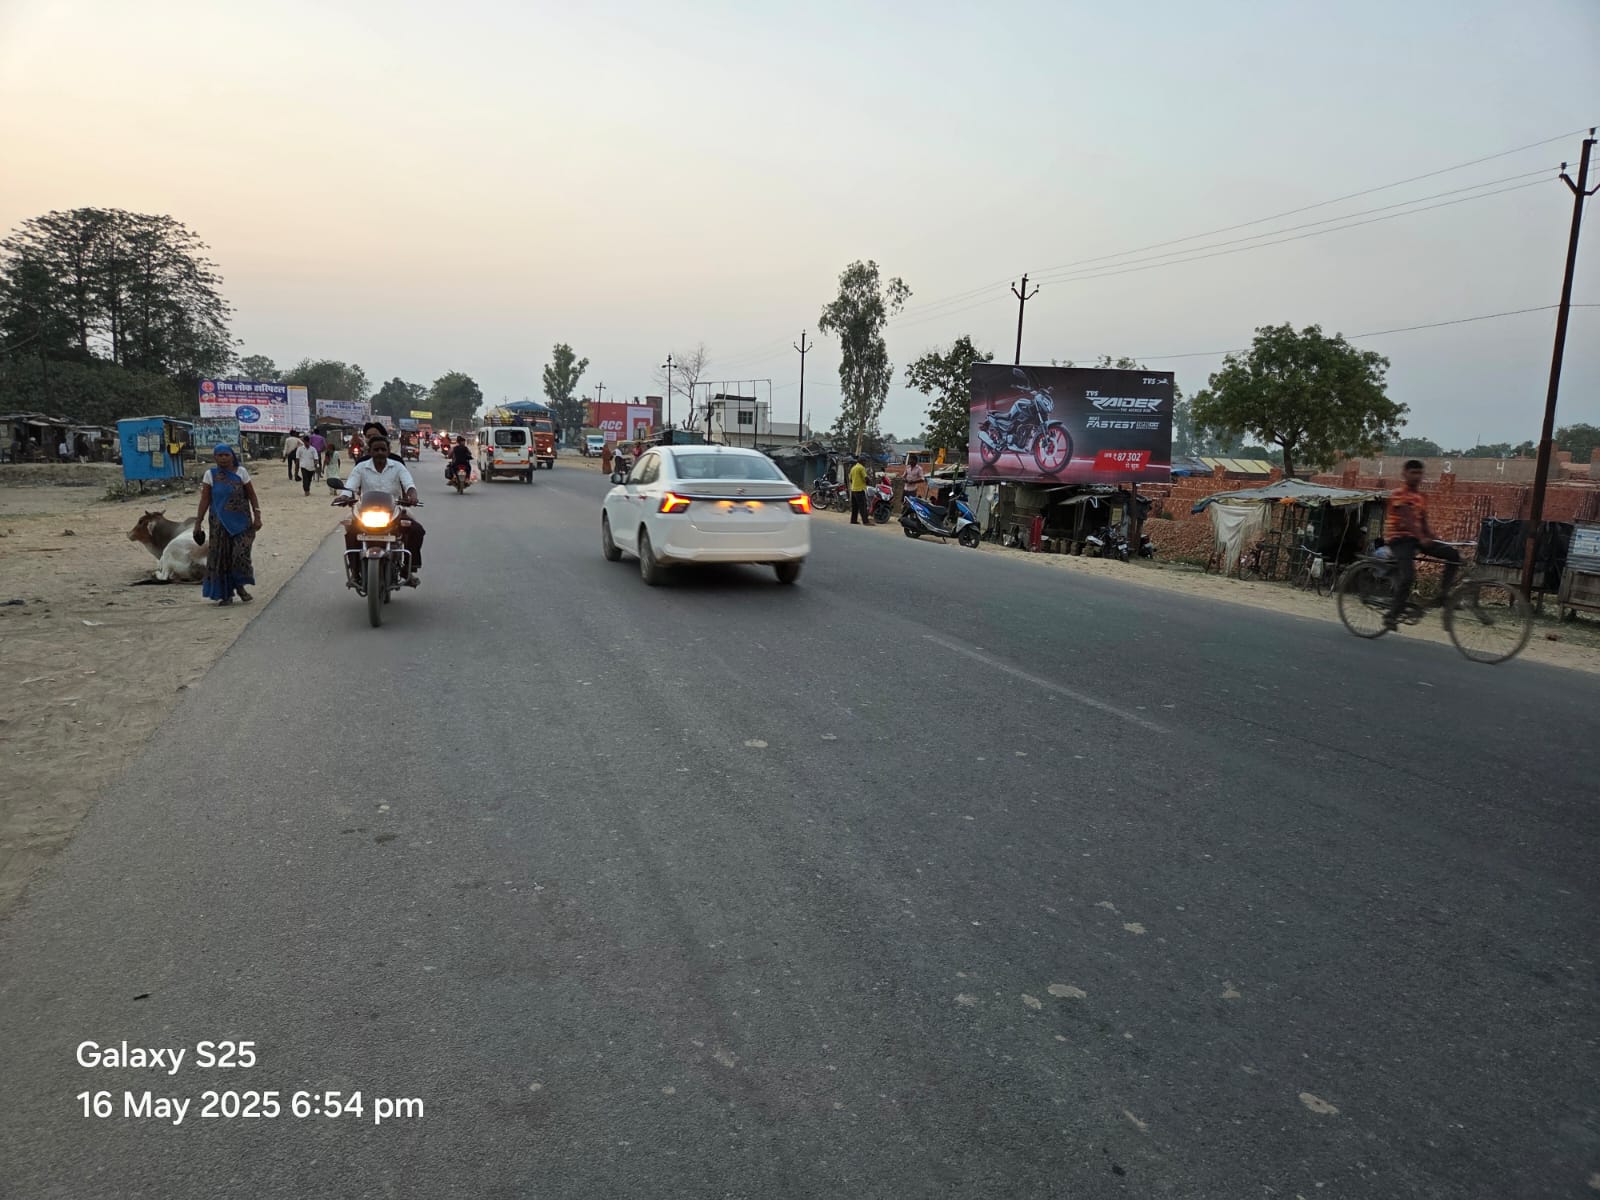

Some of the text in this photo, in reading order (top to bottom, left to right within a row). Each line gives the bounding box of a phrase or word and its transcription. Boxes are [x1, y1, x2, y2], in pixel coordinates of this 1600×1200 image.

[1085, 396, 1162, 412] RAIDER
[599, 420, 623, 430] ACC
[1443, 461, 1452, 473] 3
[1496, 461, 1505, 475] 4
